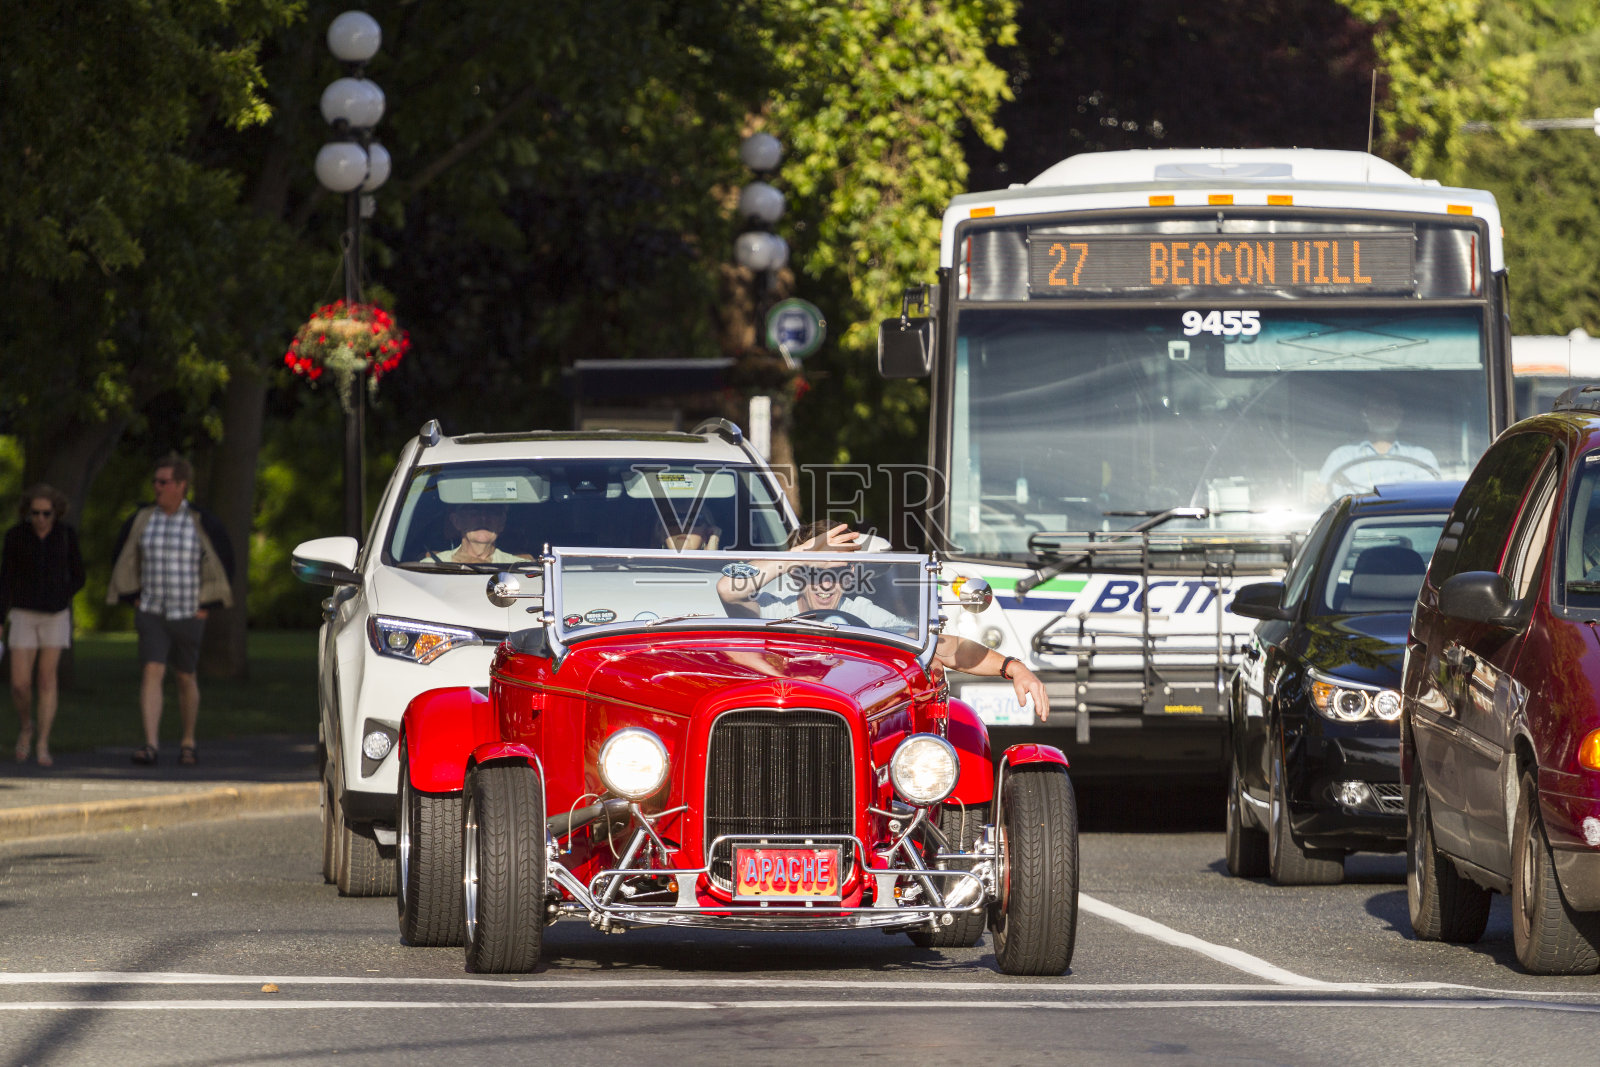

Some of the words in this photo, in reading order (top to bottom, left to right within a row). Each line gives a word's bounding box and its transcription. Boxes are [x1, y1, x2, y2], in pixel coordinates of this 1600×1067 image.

[1048, 243, 1089, 286] 27
[1150, 241, 1275, 285] BEACON
[1292, 240, 1372, 284] HILL
[1181, 310, 1261, 336] 9455
[1089, 580, 1236, 613] BCTr
[746, 858, 829, 883] APACHE
